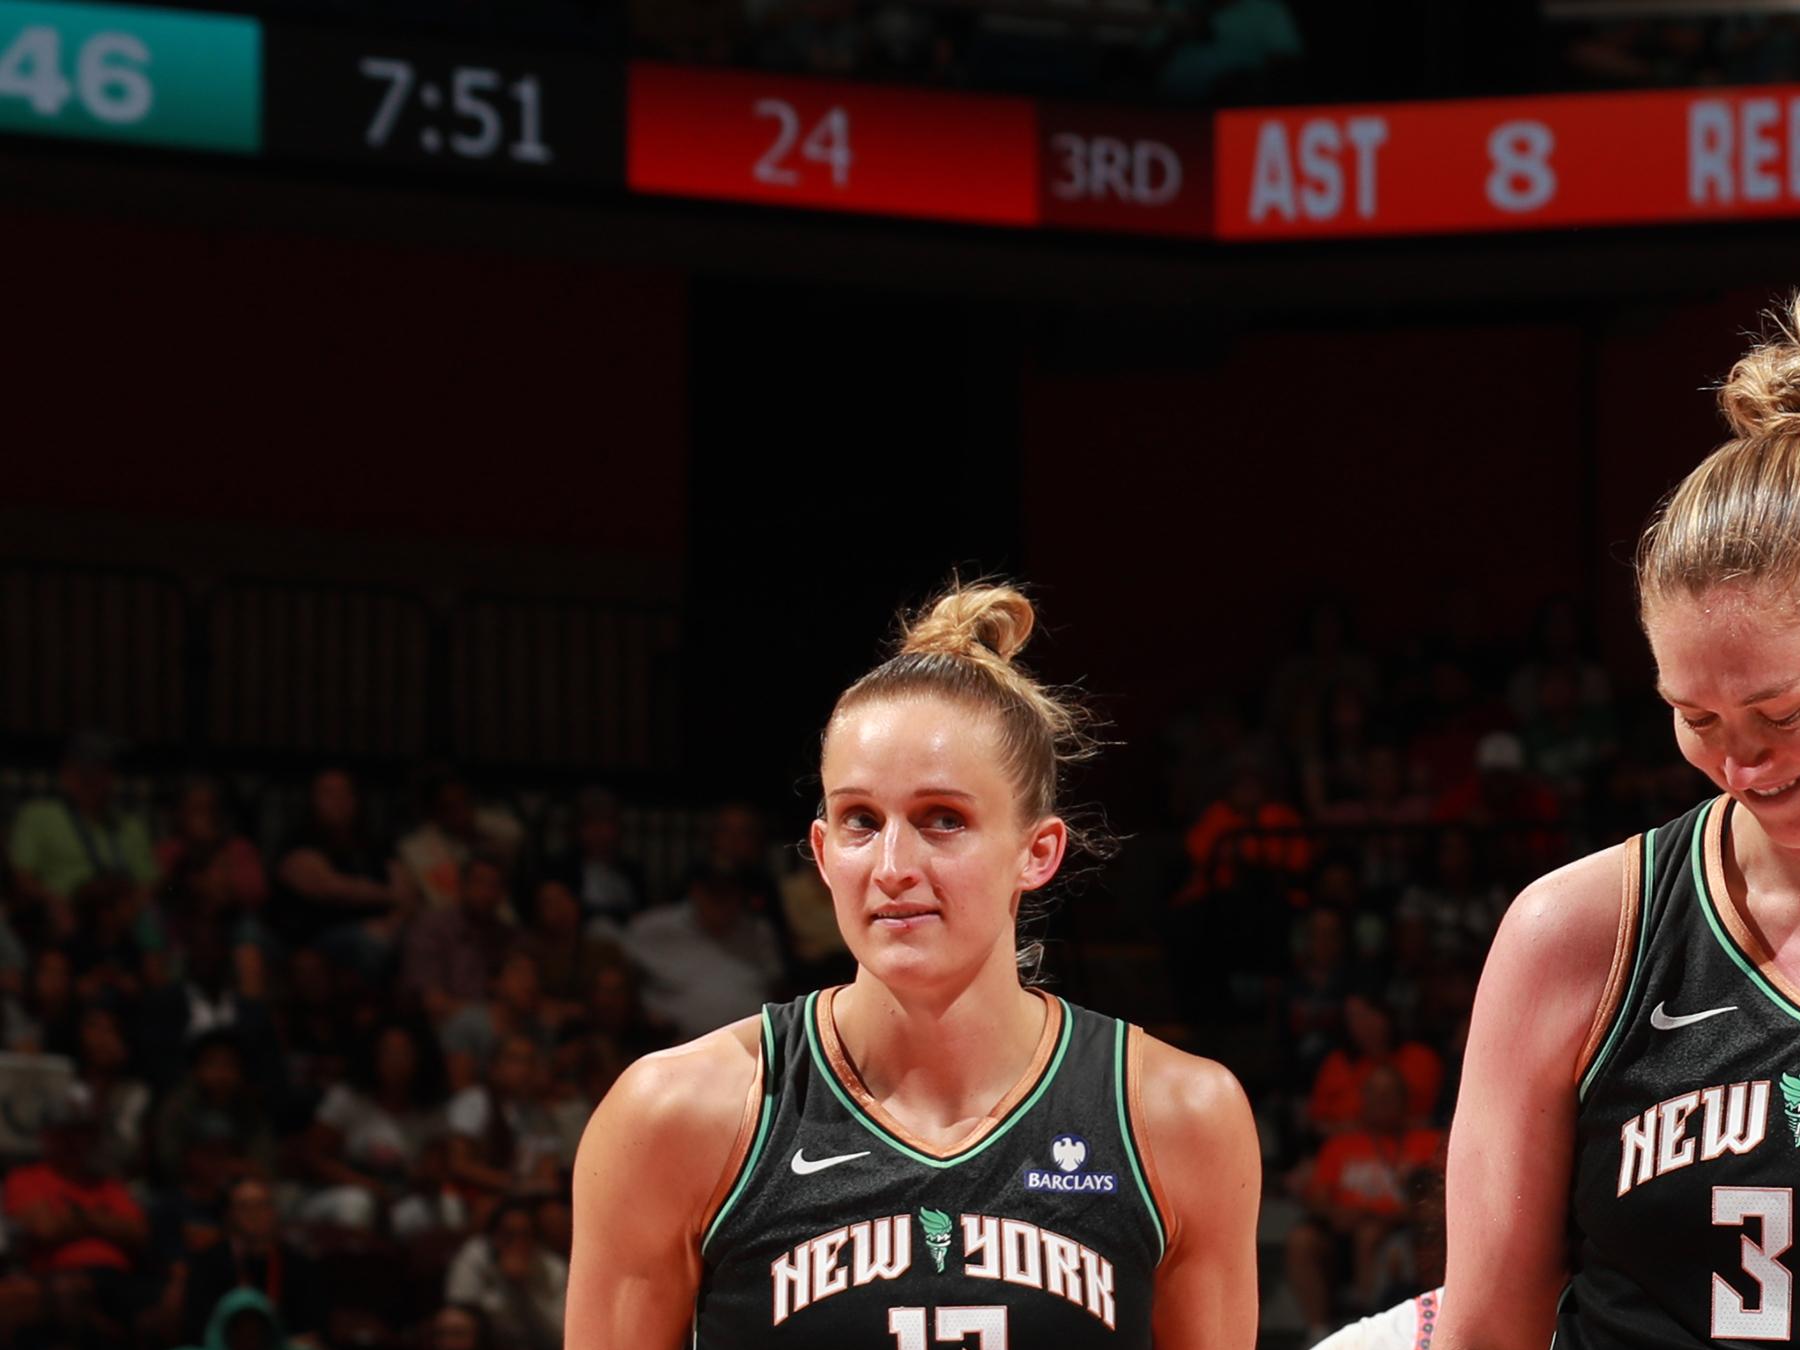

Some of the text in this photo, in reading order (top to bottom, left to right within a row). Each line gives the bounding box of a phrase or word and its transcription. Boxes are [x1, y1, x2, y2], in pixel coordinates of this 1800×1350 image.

[0, 26, 152, 122] 46
[361, 60, 551, 162] 7:51
[752, 101, 855, 188] 24
[1050, 135, 1182, 203] 3RD
[1250, 118, 1387, 221] AST
[1487, 122, 1556, 211] 8
[1028, 1171, 1114, 1191] BARCLAYS
[1617, 1080, 1771, 1199] NEW
[770, 1213, 1116, 1333] NEW YORK
